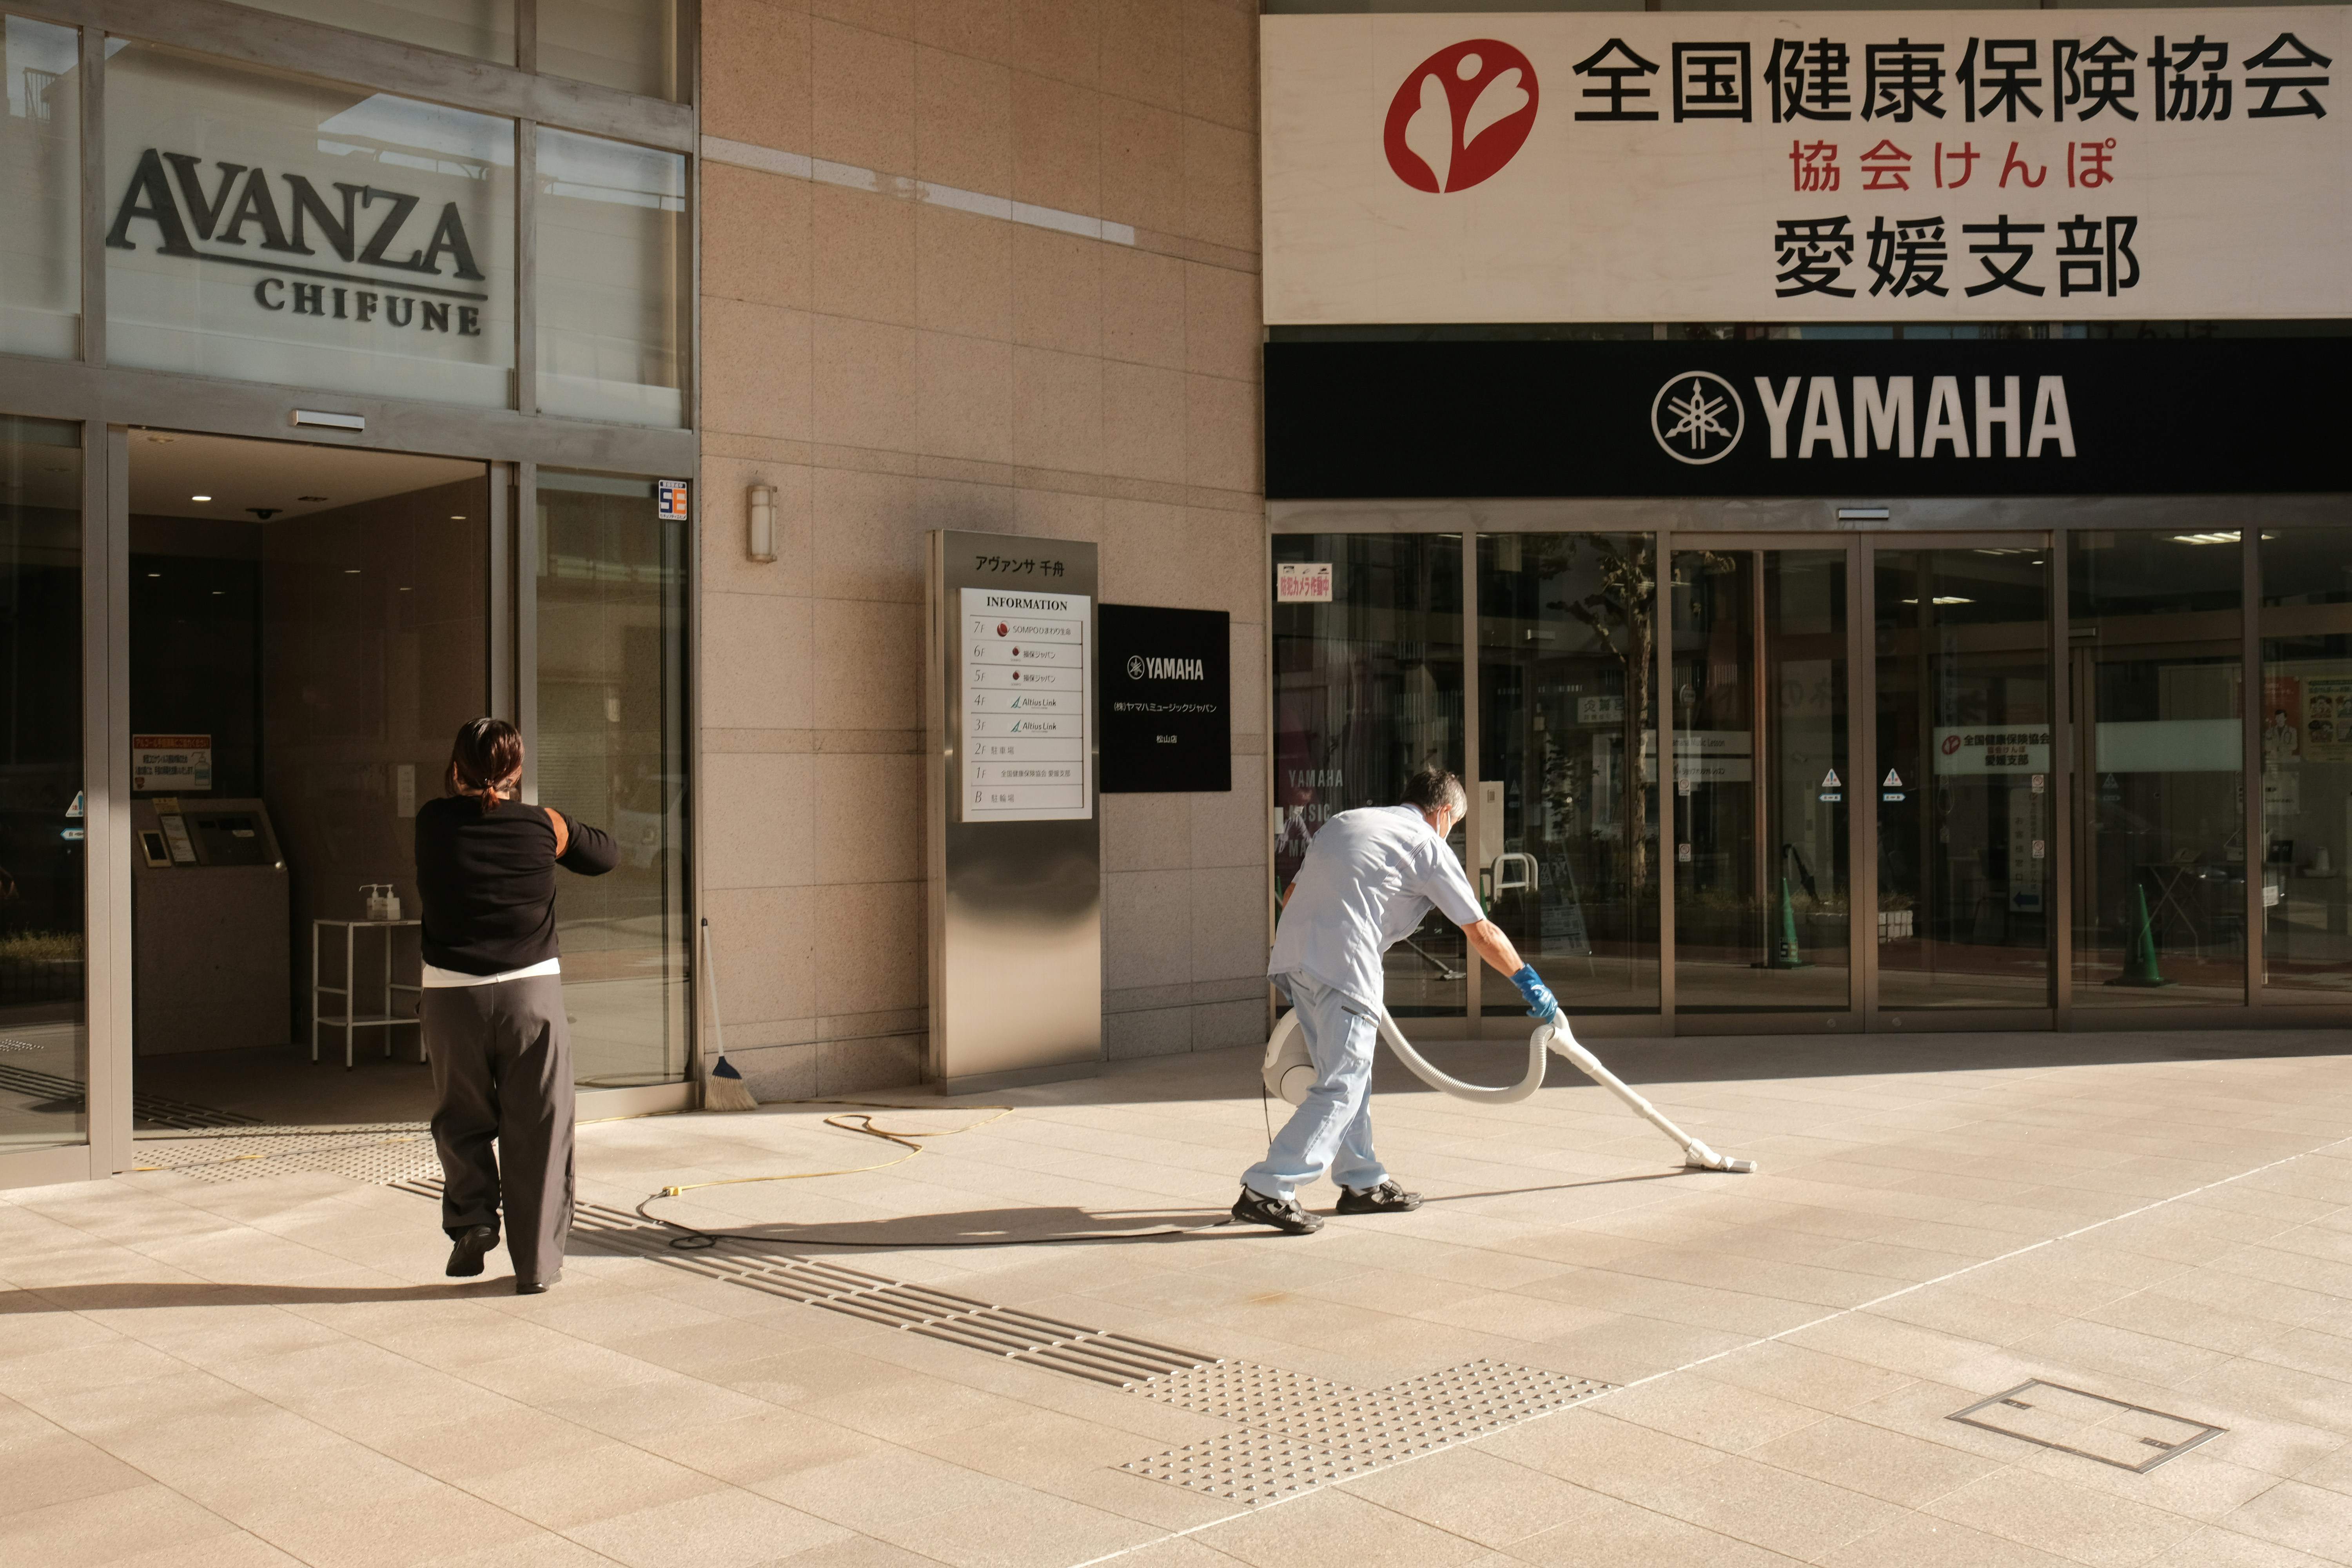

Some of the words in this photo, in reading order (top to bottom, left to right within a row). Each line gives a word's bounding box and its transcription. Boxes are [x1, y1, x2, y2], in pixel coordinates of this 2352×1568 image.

[1572, 32, 2333, 123] 全国健康保険協会
[1789, 137, 2116, 192] 協会けんぽ
[105, 149, 486, 281] AVANZA
[1774, 214, 2140, 298] 愛媛支部
[254, 277, 481, 336] CHIFUNE
[1754, 375, 2076, 459] YAMAHA
[1040, 560, 1065, 577] 千舟
[1280, 575, 1330, 596] 防犯カメラ作動中
[986, 596, 1068, 612] INFORMATION
[974, 621, 985, 633] 7F
[974, 645, 985, 657] 6F
[974, 669, 986, 682] 5F
[1145, 657, 1204, 681] YAMAHA
[974, 694, 986, 706] 4F
[1022, 698, 1042, 707] Altius
[1042, 698, 1057, 707] Link
[974, 718, 986, 731] 3F
[1022, 722, 1042, 731] Altius
[1042, 722, 1057, 731] Link
[1156, 735, 1178, 744] 松山店
[1964, 733, 2050, 746] 全国健康保険協会
[974, 742, 986, 755] 2F
[1985, 754, 2029, 766] 愛媛支部
[976, 767, 986, 779] 1F
[1288, 769, 1343, 788] YAMAHA
[975, 791, 982, 802] B
[1289, 803, 1330, 822] MUSIC
